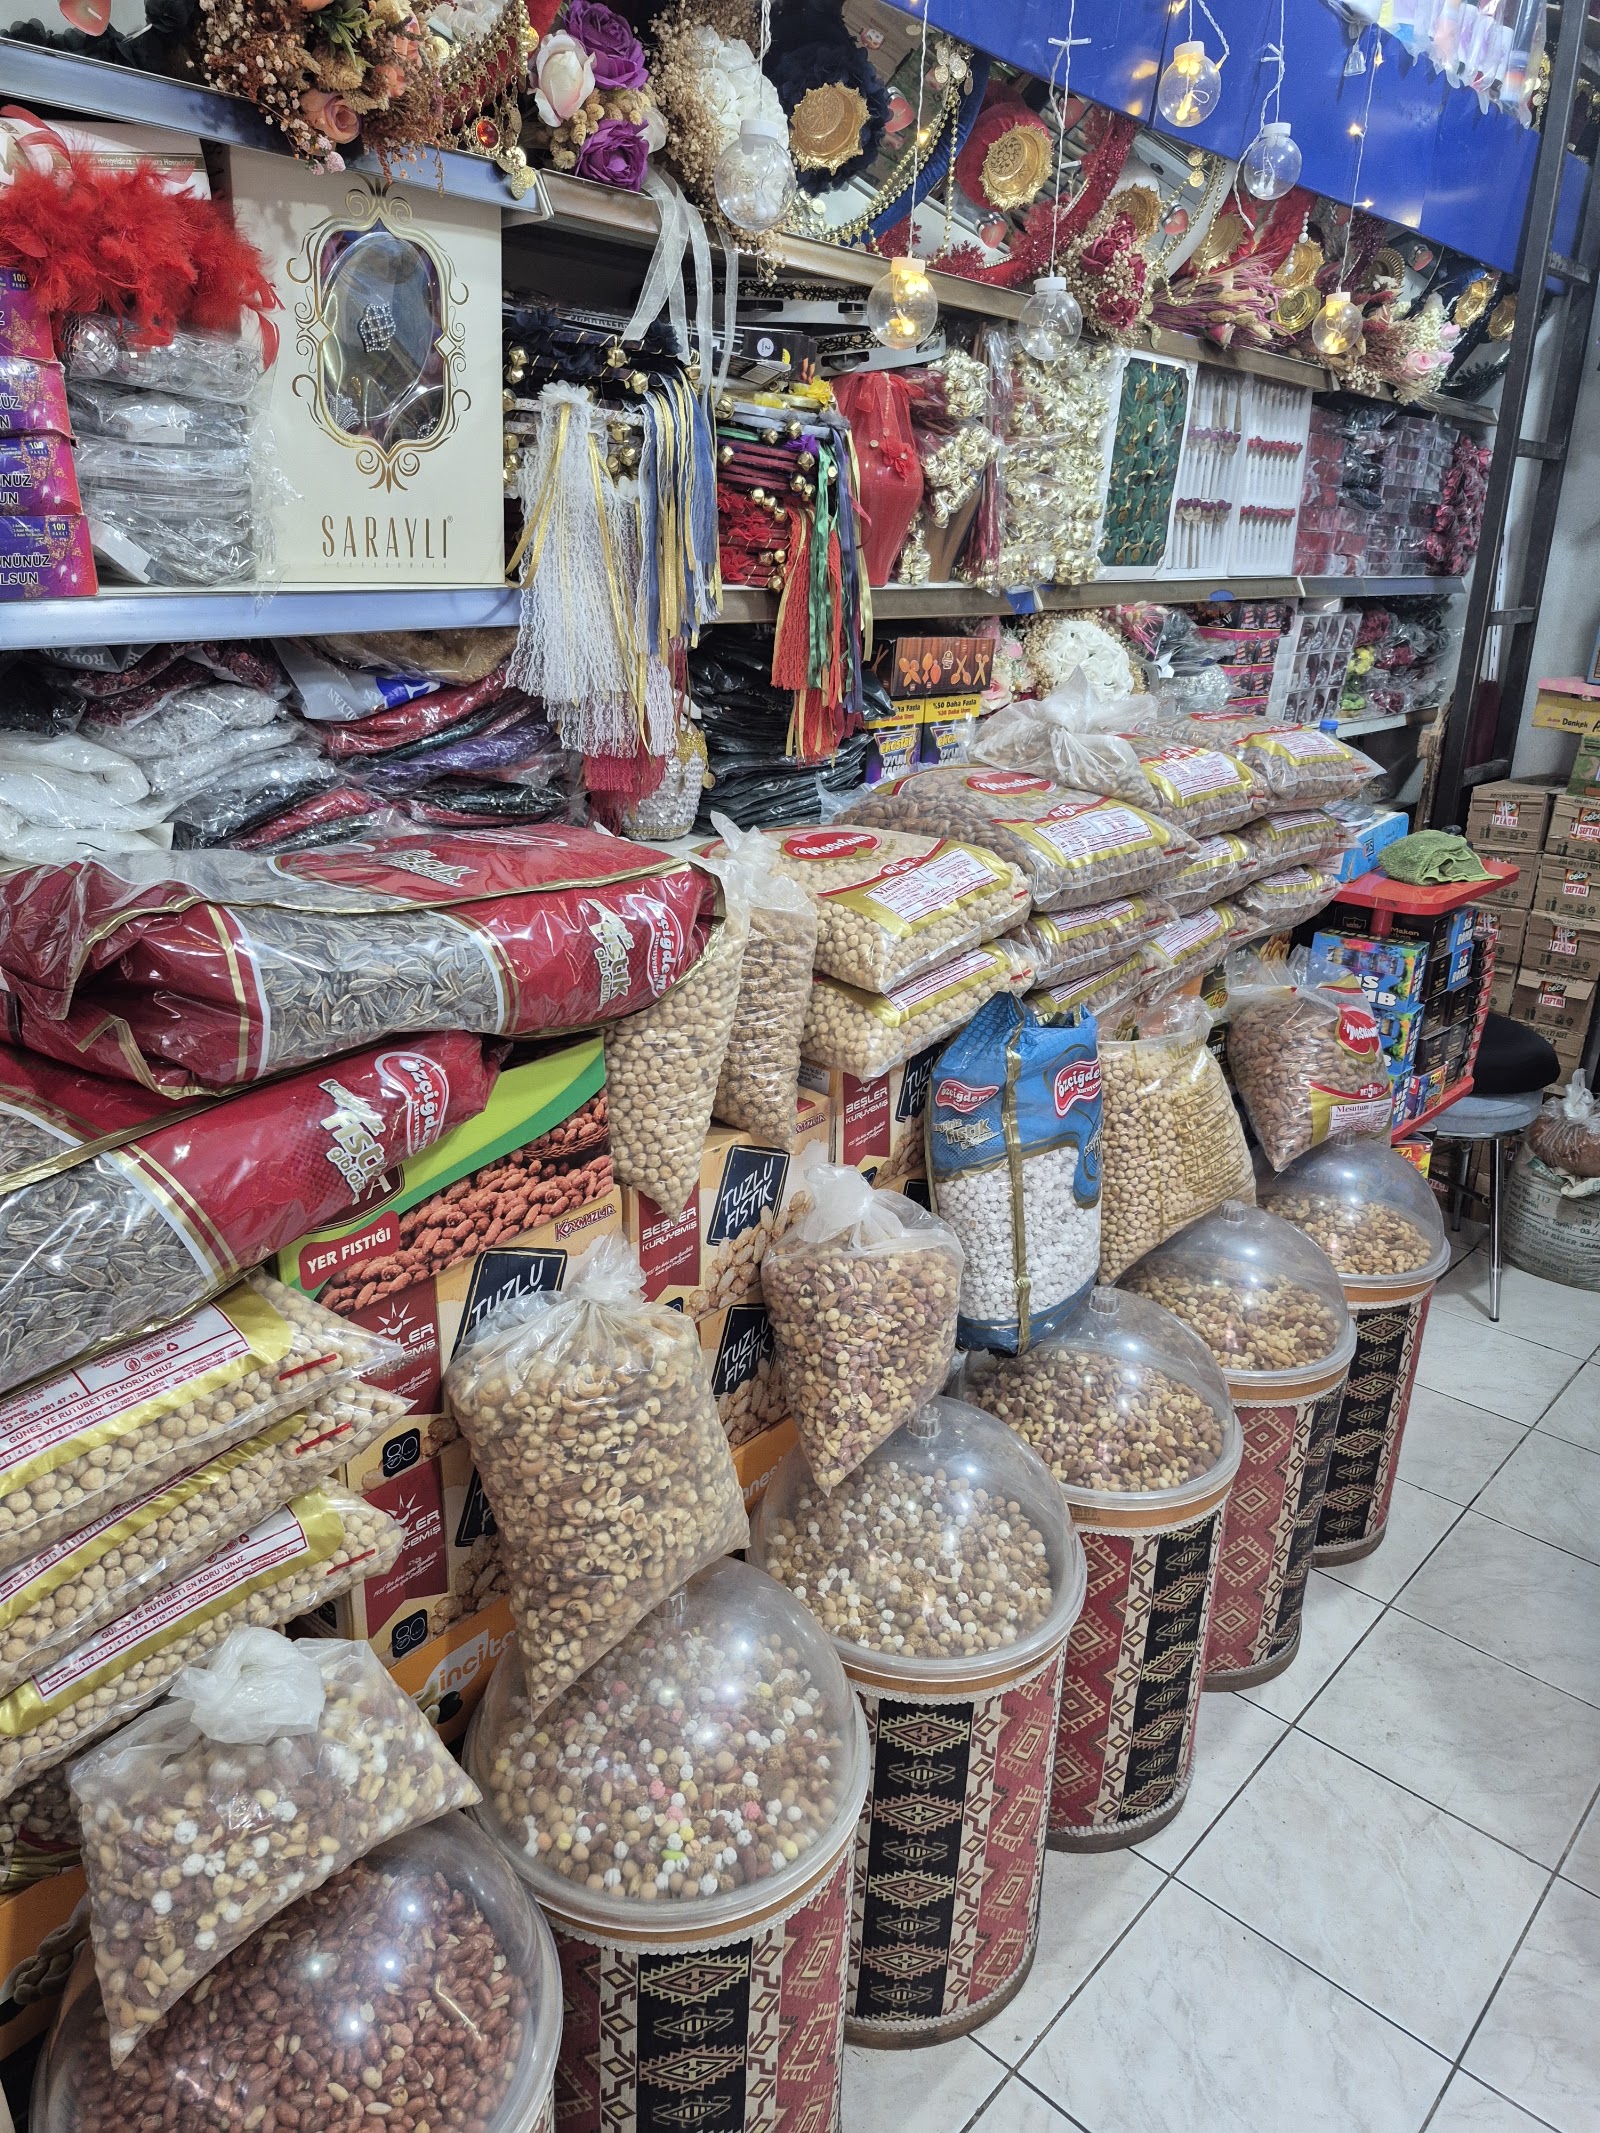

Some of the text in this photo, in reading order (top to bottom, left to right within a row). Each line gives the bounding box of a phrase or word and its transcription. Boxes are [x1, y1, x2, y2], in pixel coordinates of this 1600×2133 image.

[12, 273, 26, 283] 100
[28, 441, 44, 450] 100
[51, 523, 66, 532] 100
[321, 514, 448, 559] SARAYLI
[1562, 717, 1589, 729] Dankek
[880, 734, 914, 755] ekostar
[1494, 815, 1518, 828] PEACH
[1552, 942, 1578, 955] PEACH
[1057, 1066, 1101, 1098] özçiğde
[940, 1086, 990, 1103] özçiğdem
[723, 1157, 774, 1215] TUZLU
[725, 1180, 774, 1236] FISTIK
[1536, 1193, 1551, 1204] 113
[1582, 1218, 1592, 1226] 03
[306, 1227, 392, 1275] YER FISTIĞI
[471, 1259, 546, 1316] TUZLU
[722, 1316, 769, 1371] TUZLU
[725, 1333, 770, 1392] FISTIK
[18, 1410, 40, 1424] 0535
[40, 1402, 56, 1414] 261
[56, 1396, 69, 1406] 47
[69, 1391, 80, 1400] 13
[8, 1422, 43, 1445] GÜNEŞ
[43, 1413, 58, 1427] VE
[131, 1611, 144, 1622] VE
